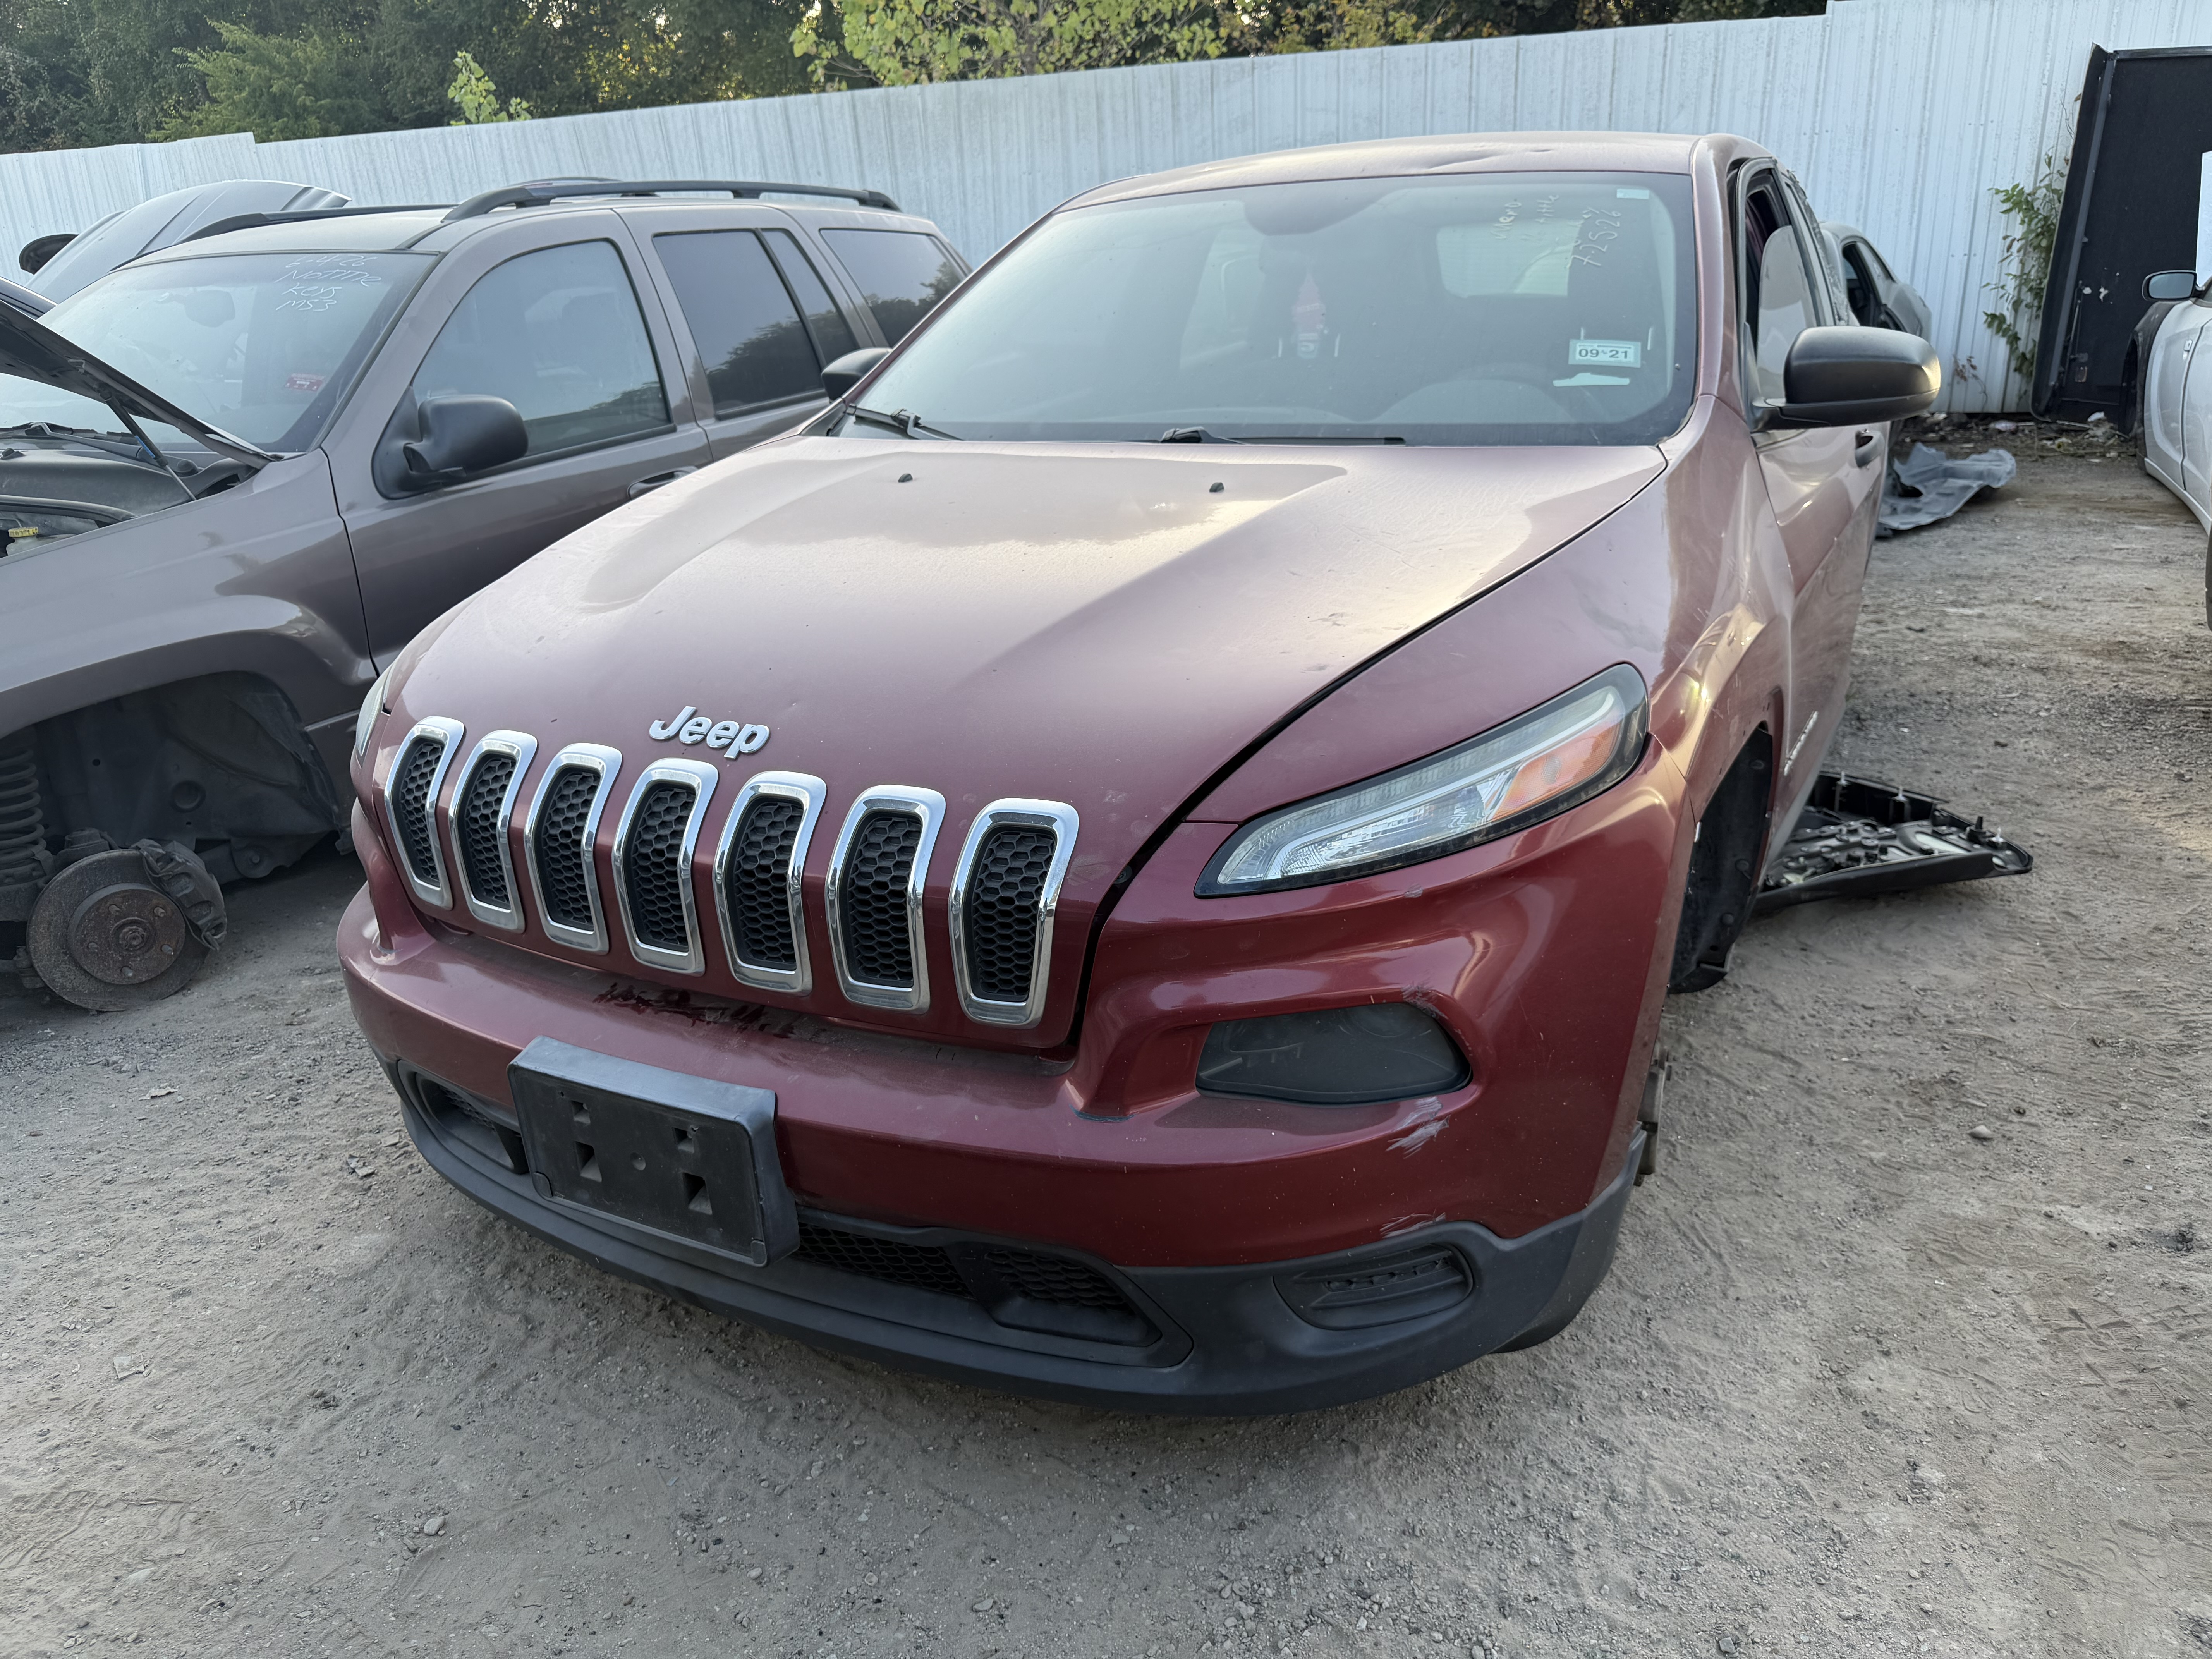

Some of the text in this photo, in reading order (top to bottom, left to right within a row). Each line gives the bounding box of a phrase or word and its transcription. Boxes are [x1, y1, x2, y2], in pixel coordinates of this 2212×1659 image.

[1579, 349, 1628, 359] 09 21
[649, 706, 770, 759] Jeep
